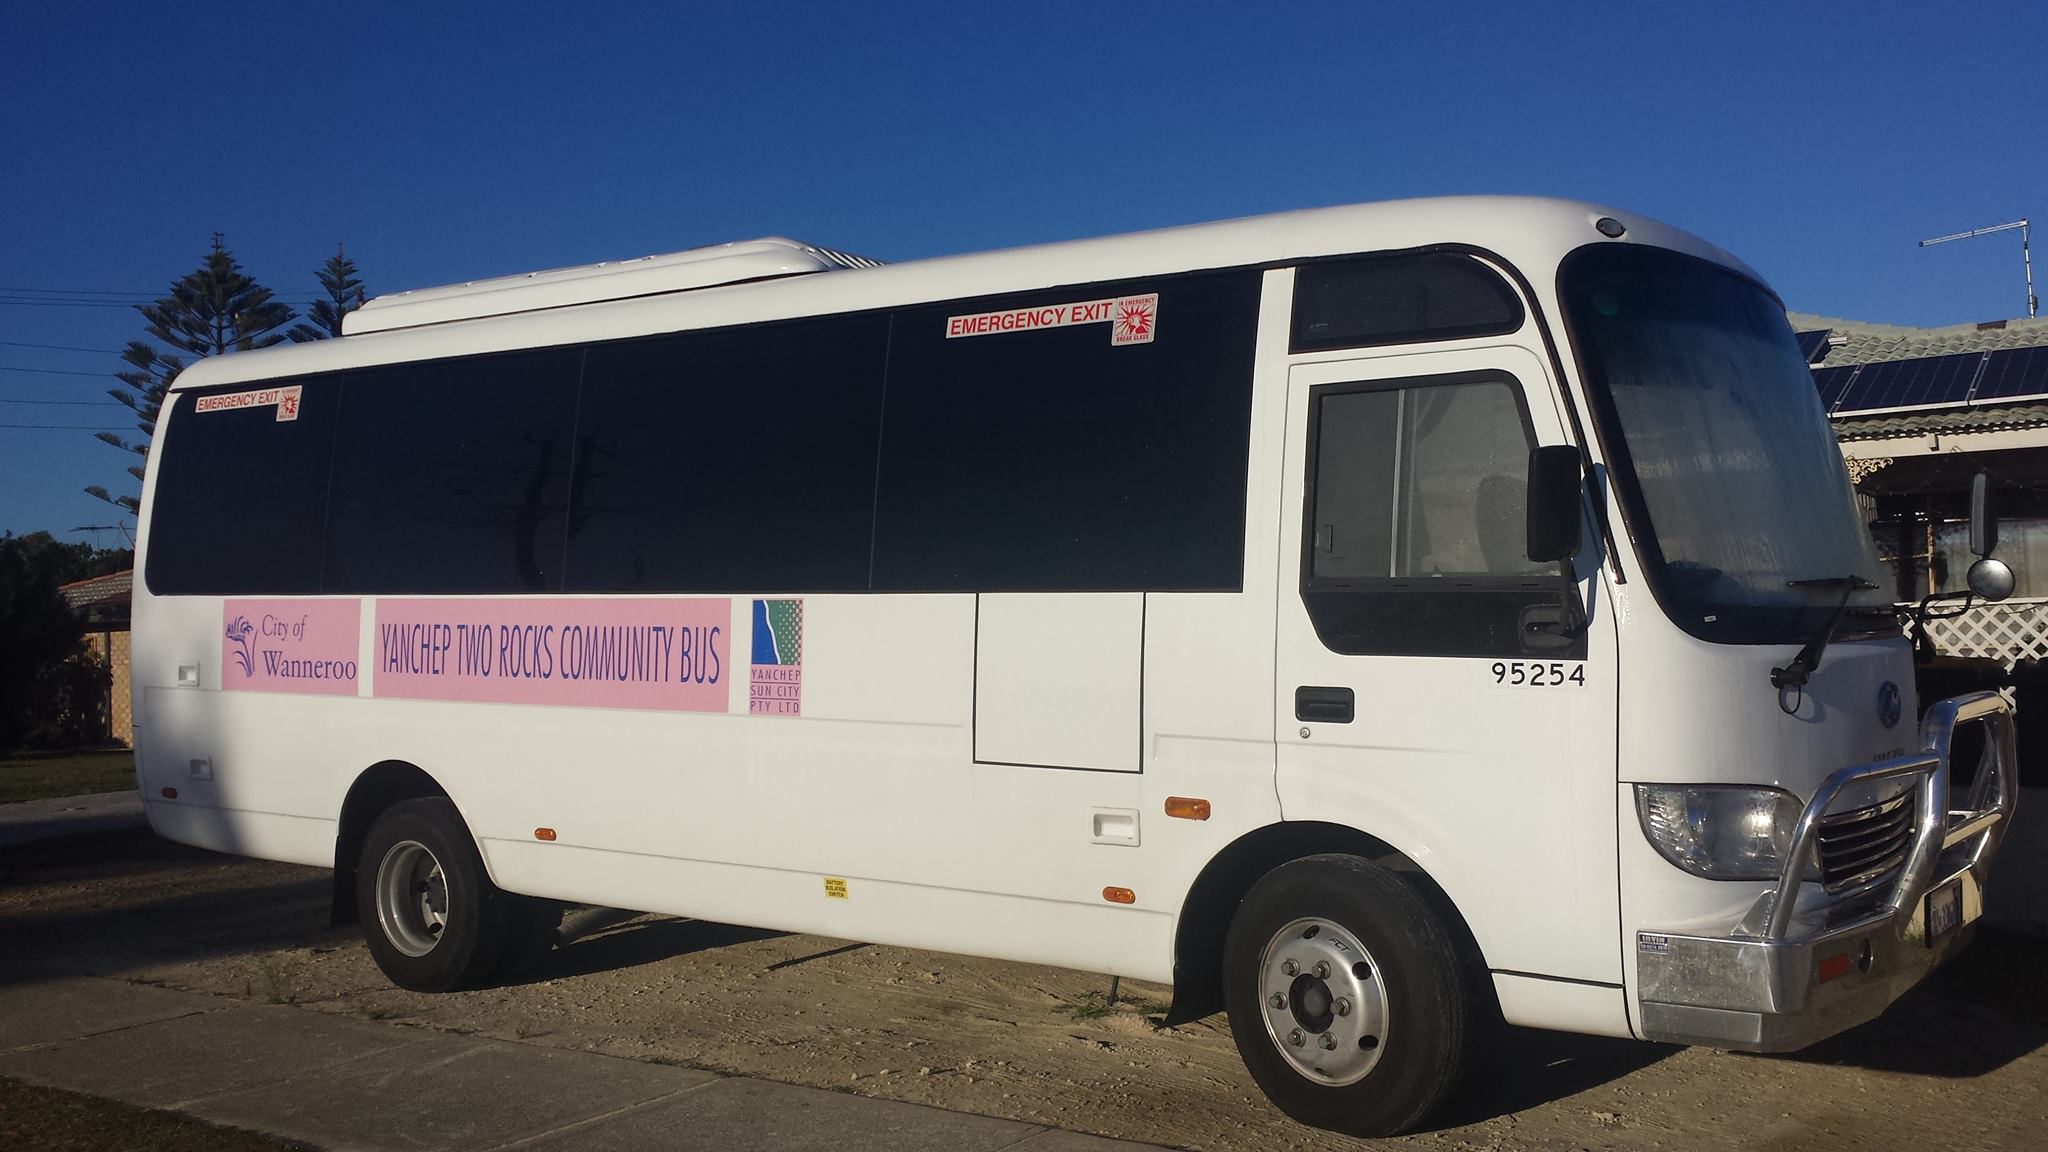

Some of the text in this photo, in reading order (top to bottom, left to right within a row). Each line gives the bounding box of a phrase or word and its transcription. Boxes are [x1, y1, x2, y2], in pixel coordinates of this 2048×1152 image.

[1124, 297, 1155, 306] EMERGENCY
[950, 302, 1113, 336] EMERGENCY EXIT
[1116, 333, 1149, 343] BREAK GLASS
[198, 394, 257, 411] EMERGENCY
[258, 390, 280, 404] EXIT
[262, 614, 308, 641] City of
[382, 623, 721, 684] YANCHEP TWO ROCKS COMMUNITY BUS
[262, 650, 357, 680] Wanneroo
[751, 669, 801, 681] YANCHEP
[1491, 662, 1585, 687] 95254
[750, 684, 800, 698] SUN CITY
[750, 700, 799, 713] PTY LTD
